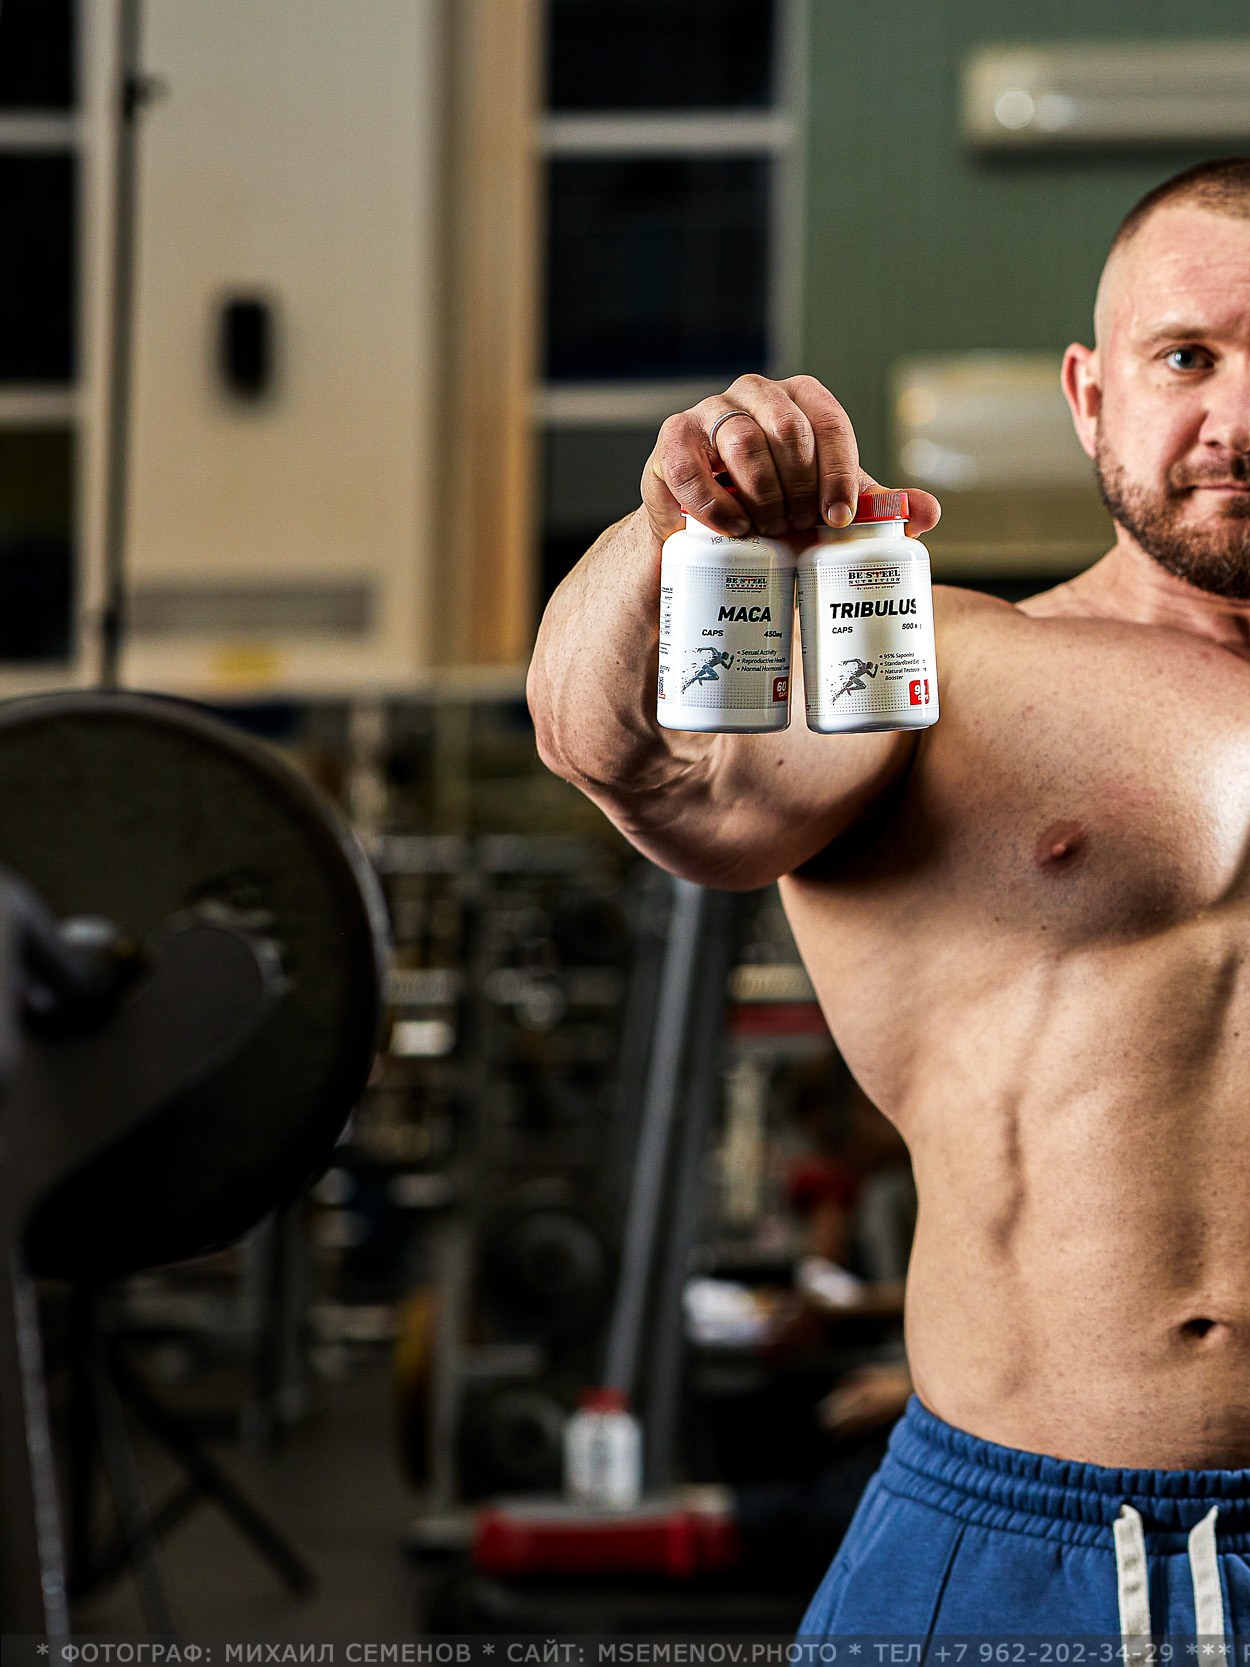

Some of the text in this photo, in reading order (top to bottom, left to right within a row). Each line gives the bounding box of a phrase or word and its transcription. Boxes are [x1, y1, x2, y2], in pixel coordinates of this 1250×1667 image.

[848, 570, 900, 579] BE STEEL
[717, 606, 772, 622] MACA
[701, 629, 724, 637] CAPS
[832, 626, 853, 634] CAPS
[884, 667, 903, 675] Natural
[776, 681, 787, 692] 60
